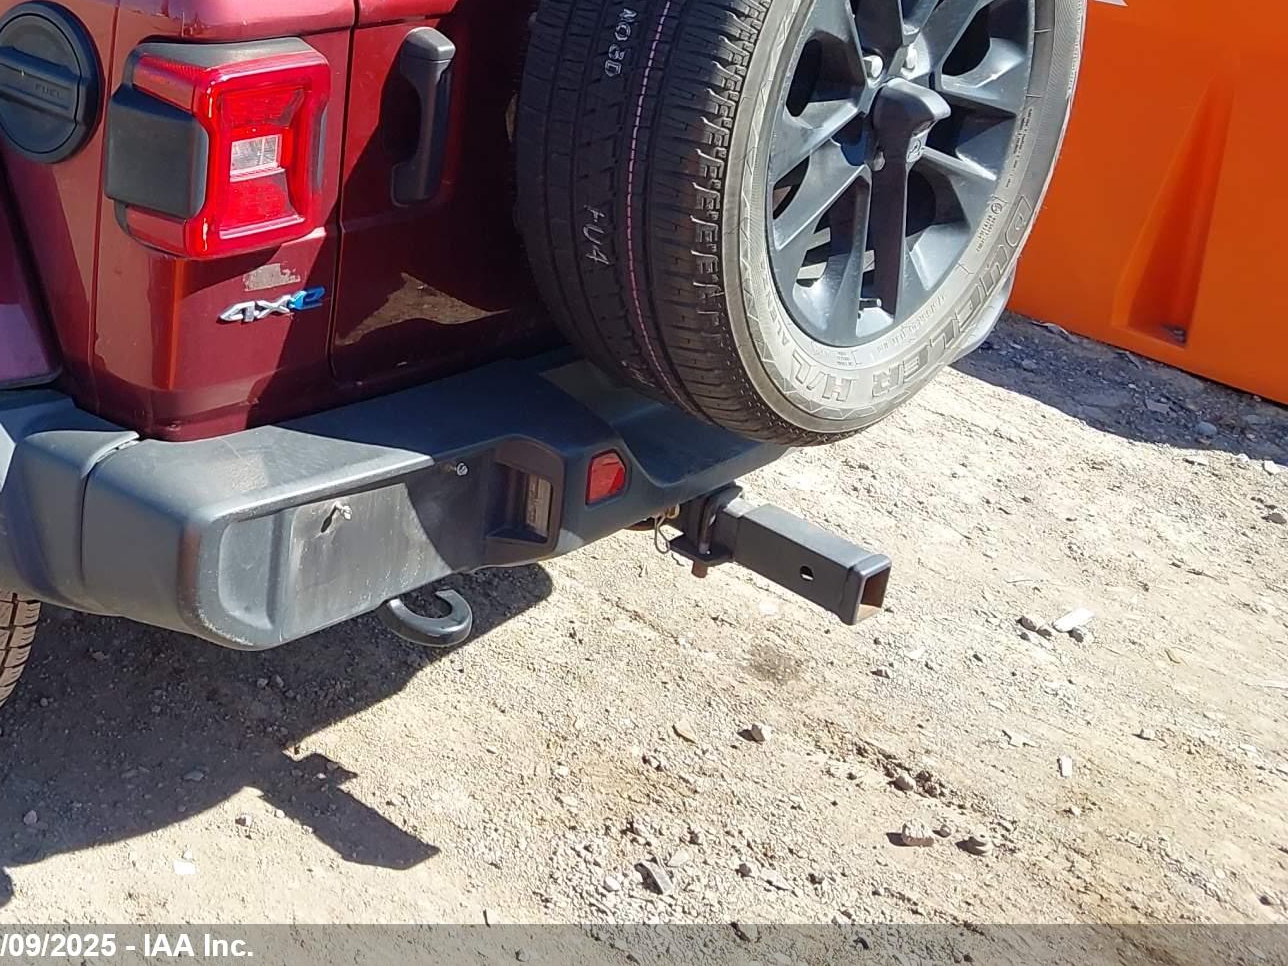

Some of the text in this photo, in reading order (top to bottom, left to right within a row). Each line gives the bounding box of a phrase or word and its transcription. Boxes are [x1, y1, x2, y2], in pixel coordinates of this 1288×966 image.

[34, 82, 64, 100] FUEL
[872, 194, 1033, 398] DUELER
[791, 348, 858, 402] H/L
